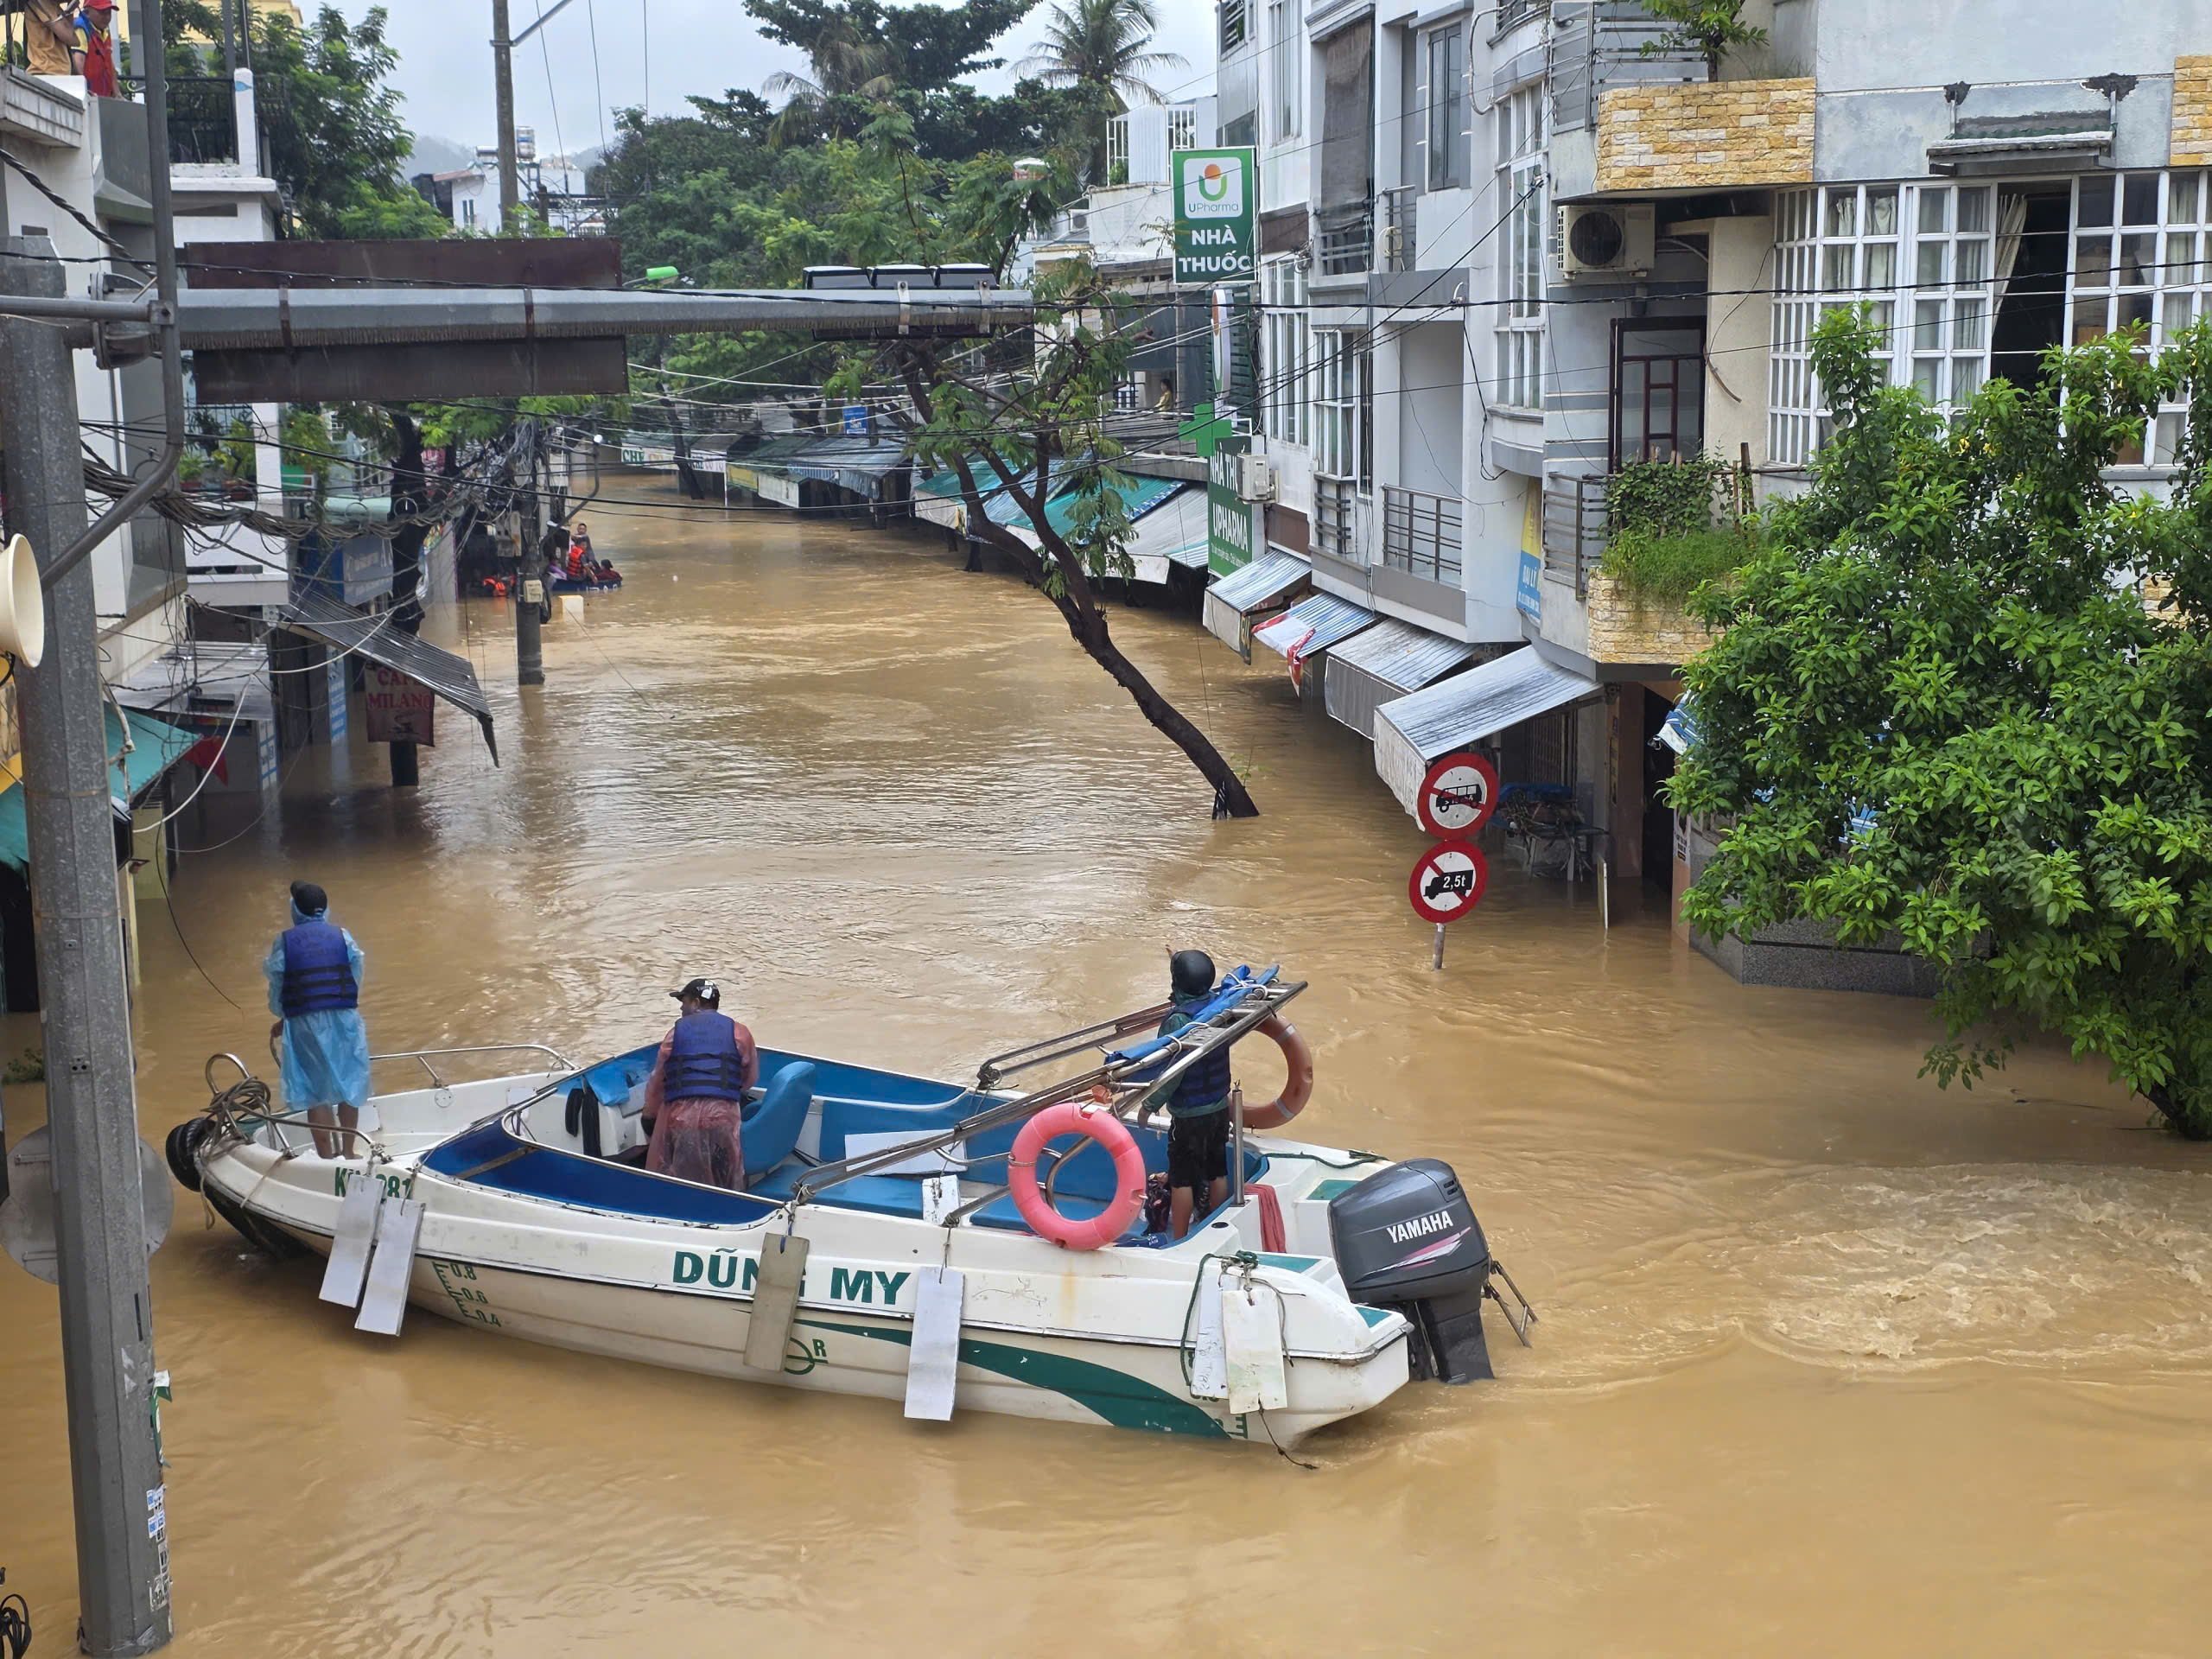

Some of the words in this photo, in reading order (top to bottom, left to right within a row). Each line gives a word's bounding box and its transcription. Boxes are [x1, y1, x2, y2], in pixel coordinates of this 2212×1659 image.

[1188, 202, 1239, 213] UPharma
[1192, 224, 1237, 245] NHÀ
[1178, 250, 1252, 273] THUỐC
[1210, 442, 1224, 487] NHÀ
[1212, 502, 1249, 553] UPHARMA
[367, 692, 433, 710] MILANO
[1443, 874, 1466, 890] 2,5t
[1386, 1211, 1453, 1243] YAMAHA
[449, 1262, 478, 1281] 0.8
[830, 1267, 912, 1306] MY
